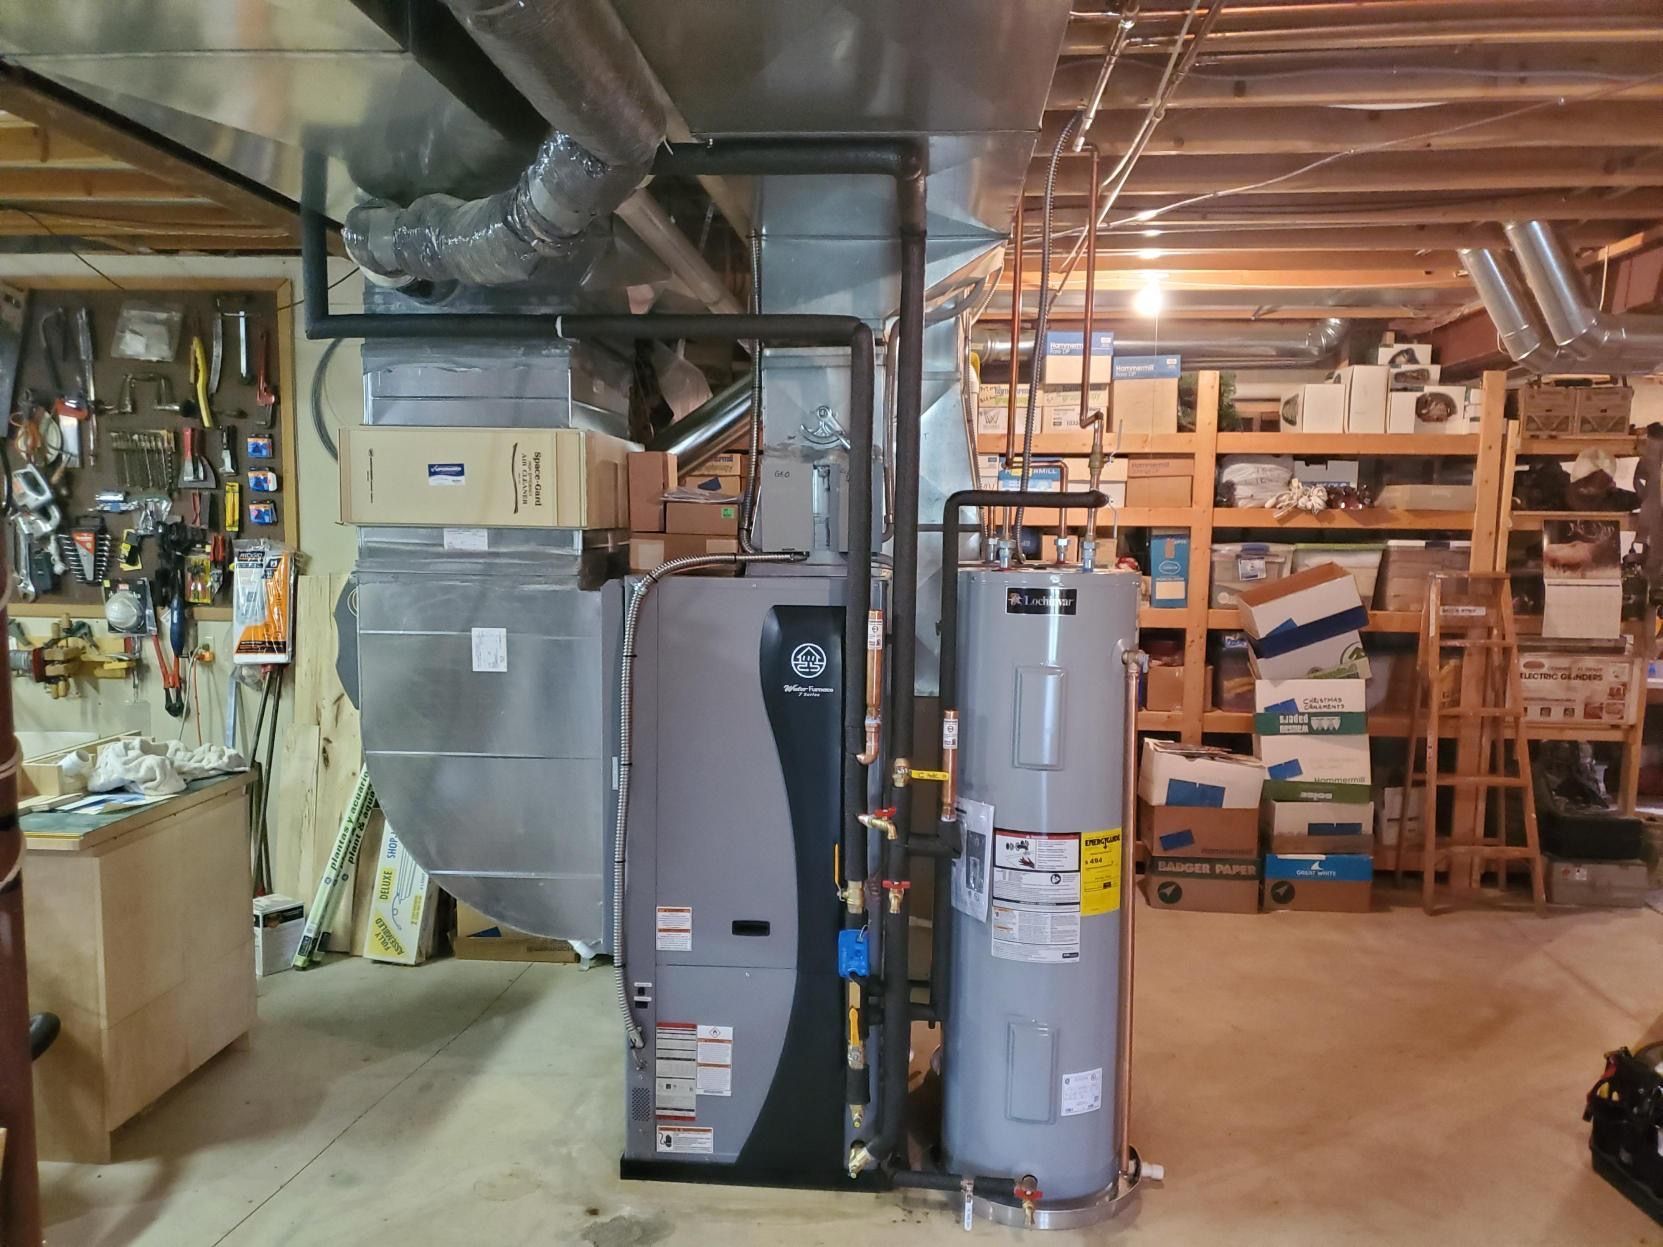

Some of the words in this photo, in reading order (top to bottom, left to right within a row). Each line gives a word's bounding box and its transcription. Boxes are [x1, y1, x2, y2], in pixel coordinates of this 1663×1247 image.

[533, 452, 542, 506] Space-Gard
[1158, 861, 1211, 874] BADGER
[1215, 864, 1257, 876] PAPER
[379, 870, 393, 900] DELUXE
